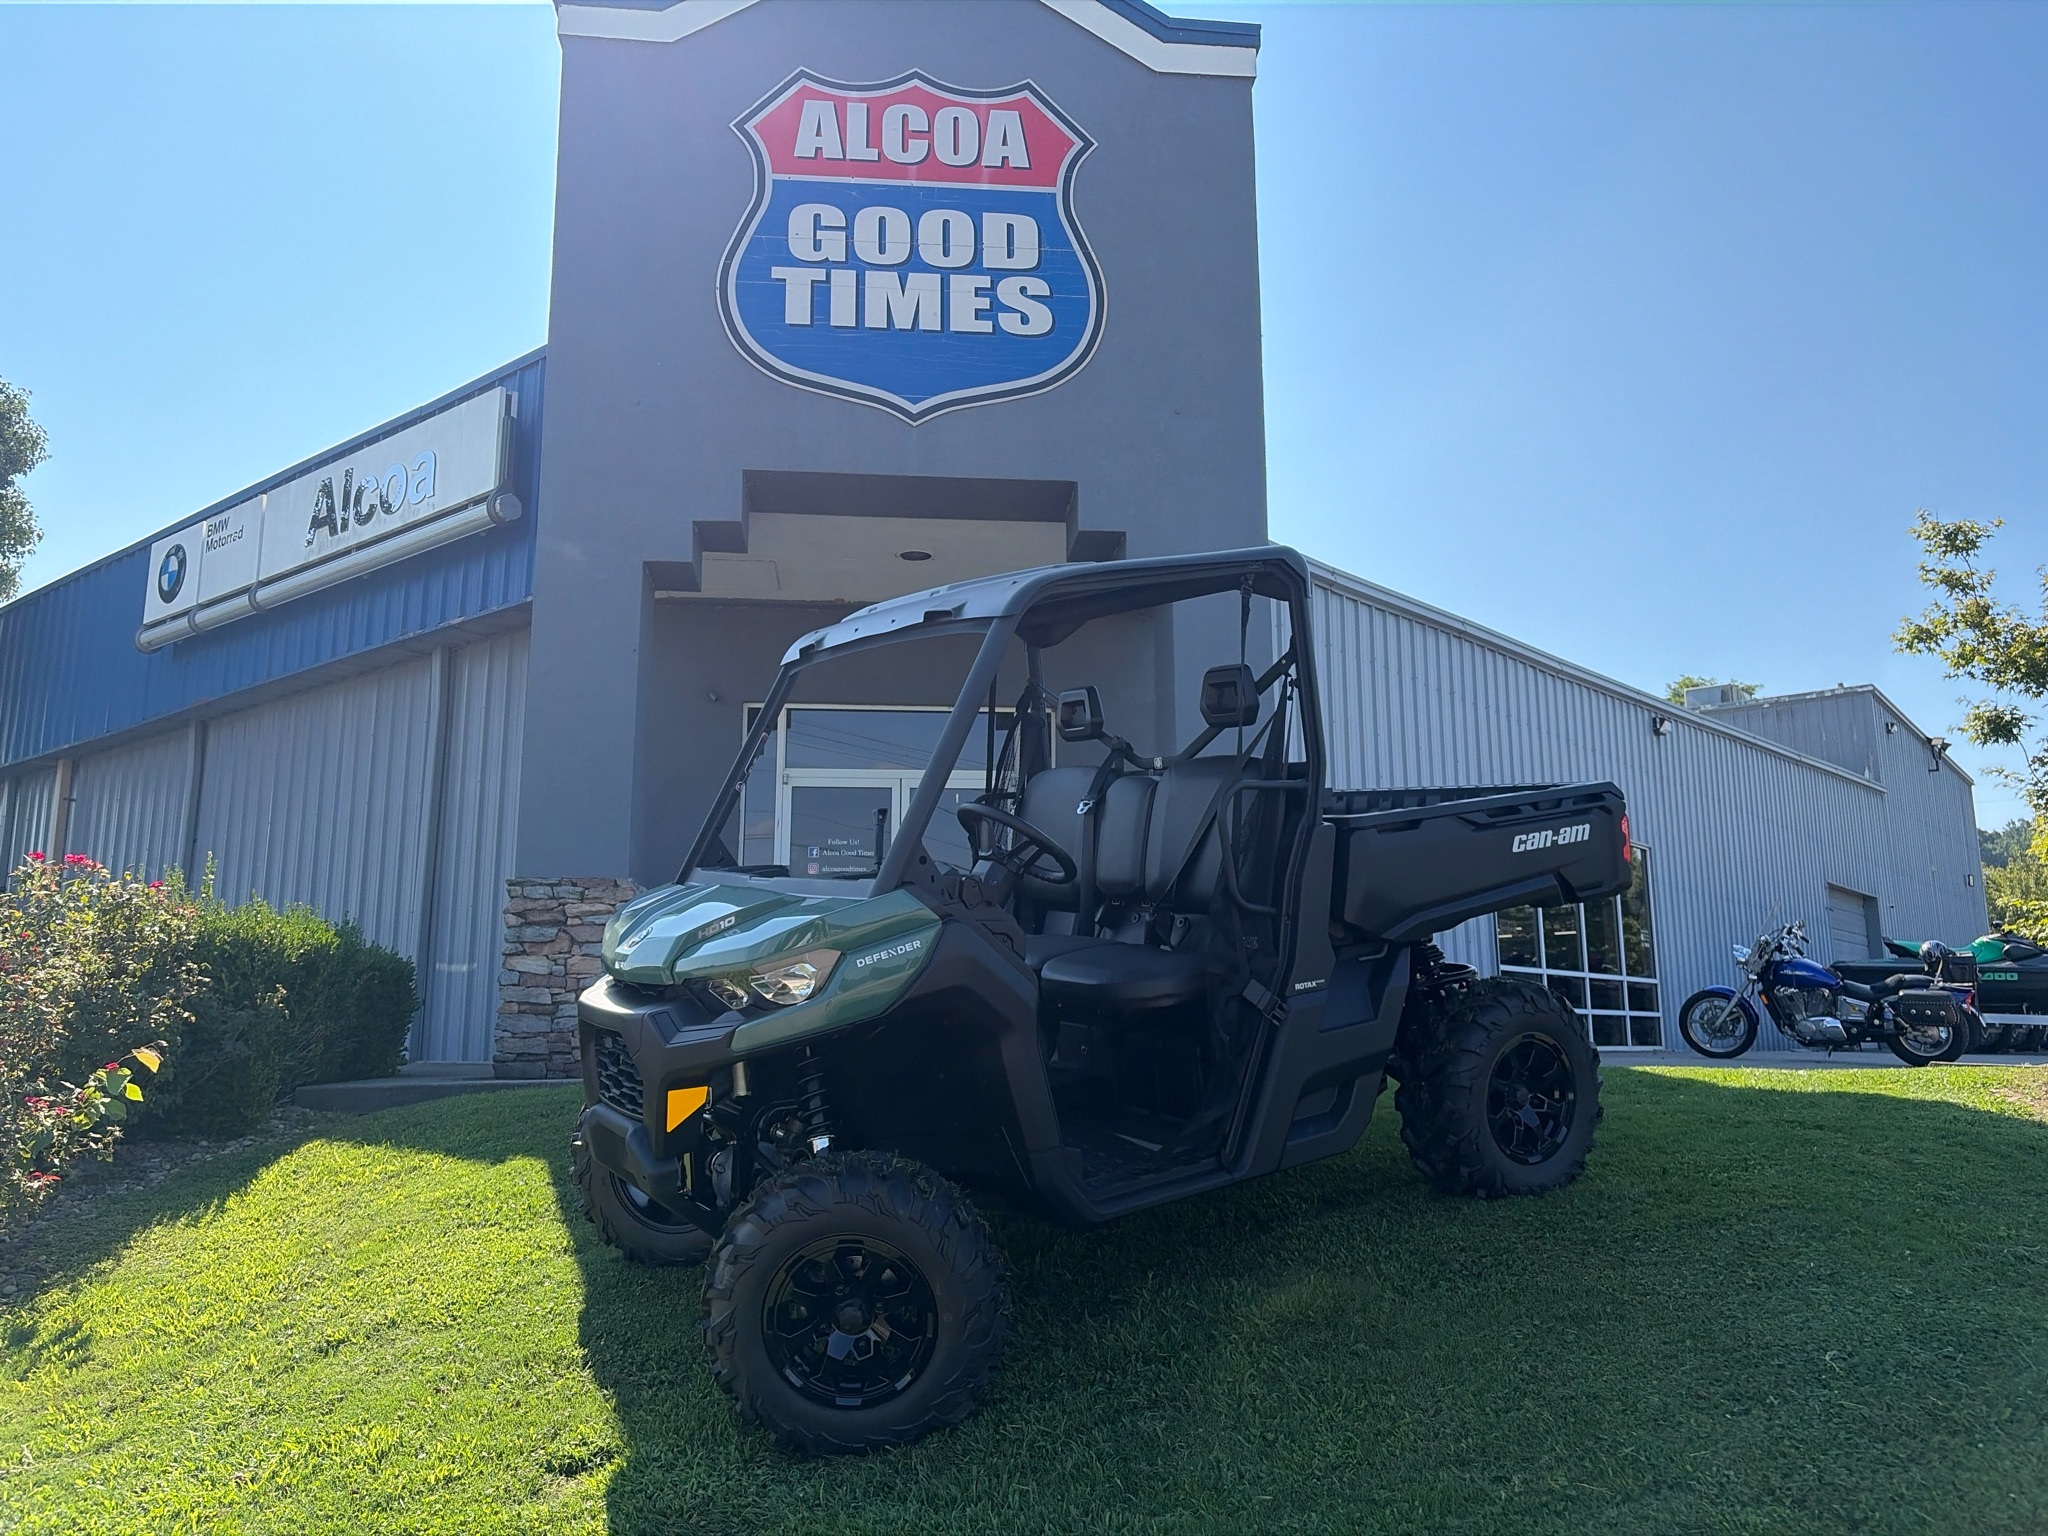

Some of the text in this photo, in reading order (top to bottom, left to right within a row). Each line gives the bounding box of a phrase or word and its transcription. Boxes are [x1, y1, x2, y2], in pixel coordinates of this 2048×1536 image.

[793, 99, 1031, 169] ALCOA
[787, 203, 1039, 270] GOOD
[771, 266, 1054, 336] TIMES
[304, 449, 437, 548] Alcoa
[205, 524, 244, 554] Motorrad
[207, 515, 230, 538] BMW
[827, 838, 860, 846] Follow Us!
[1512, 823, 1591, 853] can-am
[698, 915, 736, 940] HD10
[856, 940, 922, 968] DEFENDER
[1294, 980, 1317, 991] ROTAX
